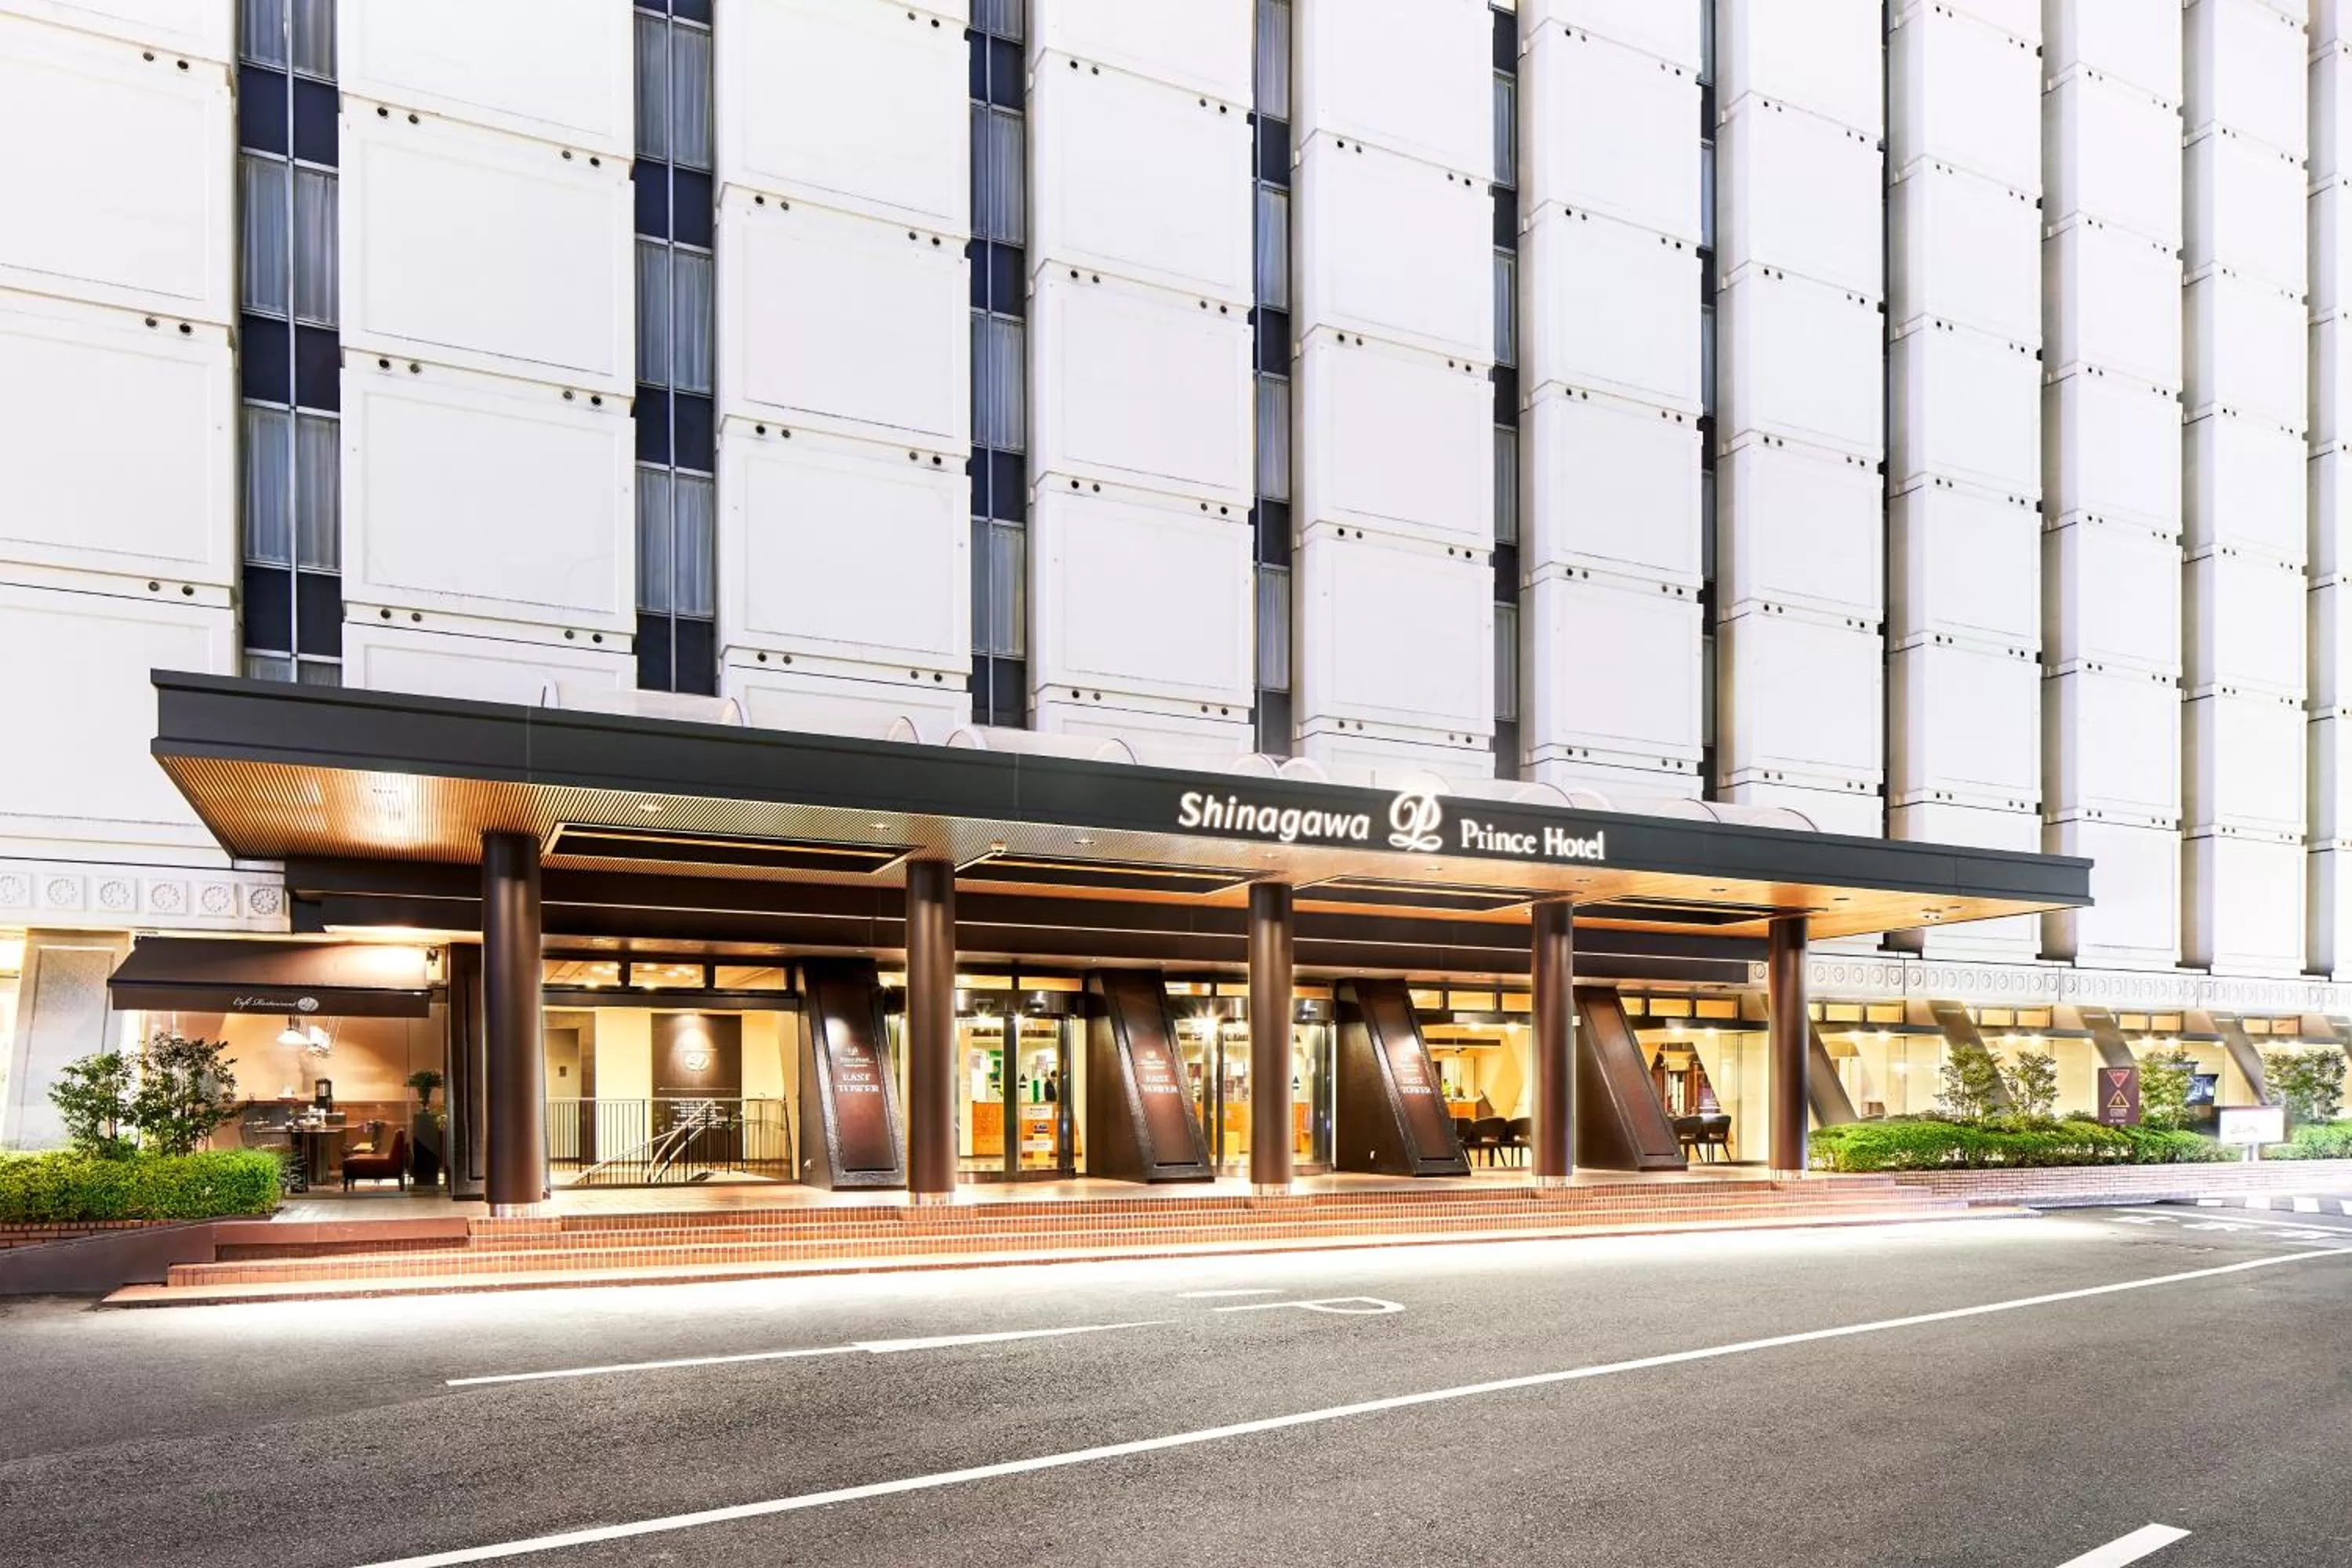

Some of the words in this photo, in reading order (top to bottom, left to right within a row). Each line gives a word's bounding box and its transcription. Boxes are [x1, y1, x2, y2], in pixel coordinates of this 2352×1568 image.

[1178, 791, 1370, 842] Shinagawa
[1460, 818, 1537, 854] Prince
[1544, 827, 1606, 860] Hotel
[842, 1073, 870, 1081] EAST
